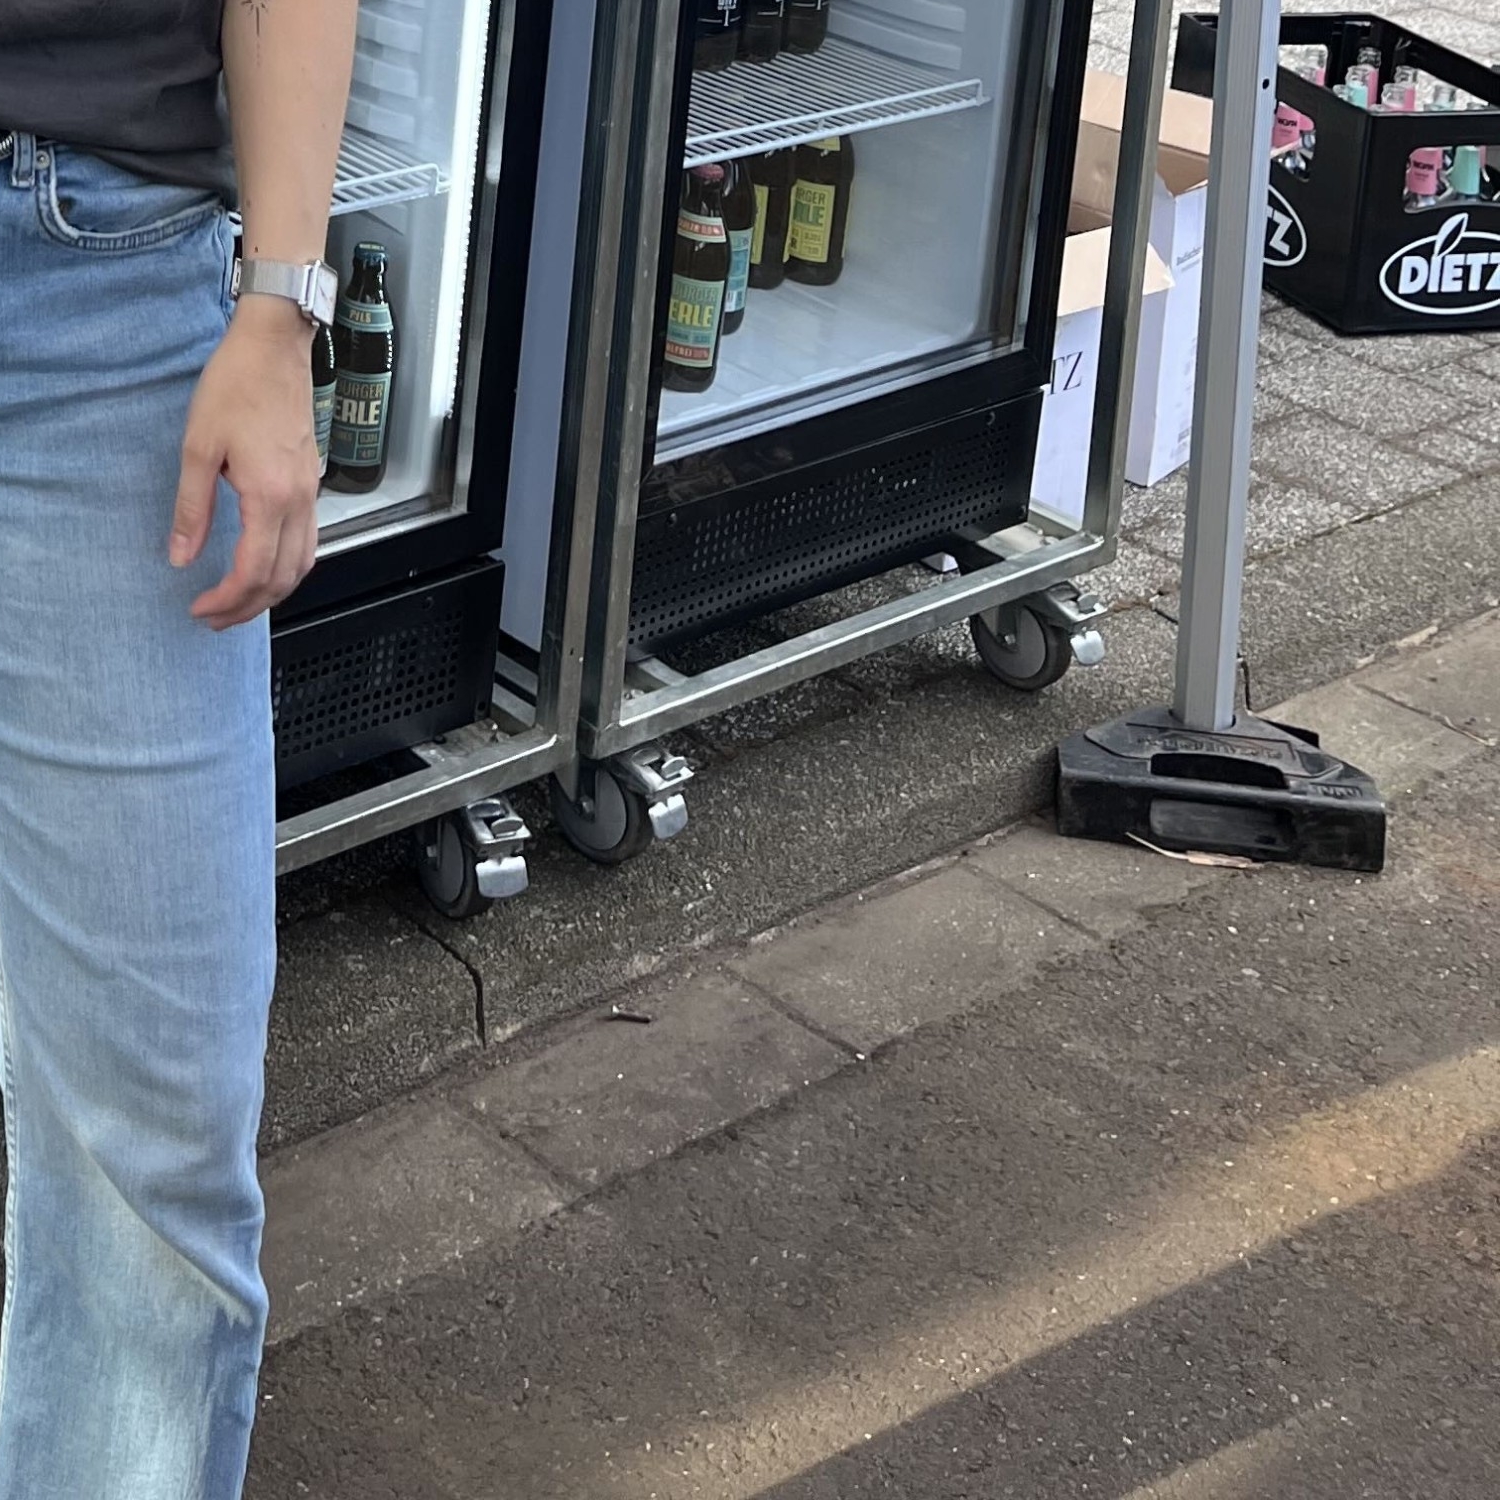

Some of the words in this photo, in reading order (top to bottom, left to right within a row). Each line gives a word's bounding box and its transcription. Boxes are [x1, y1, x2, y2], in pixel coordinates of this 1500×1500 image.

[350, 310, 372, 323] PILS
[670, 301, 714, 327] ERLE
[1049, 351, 1083, 396] TZ
[334, 400, 381, 425] ERLE
